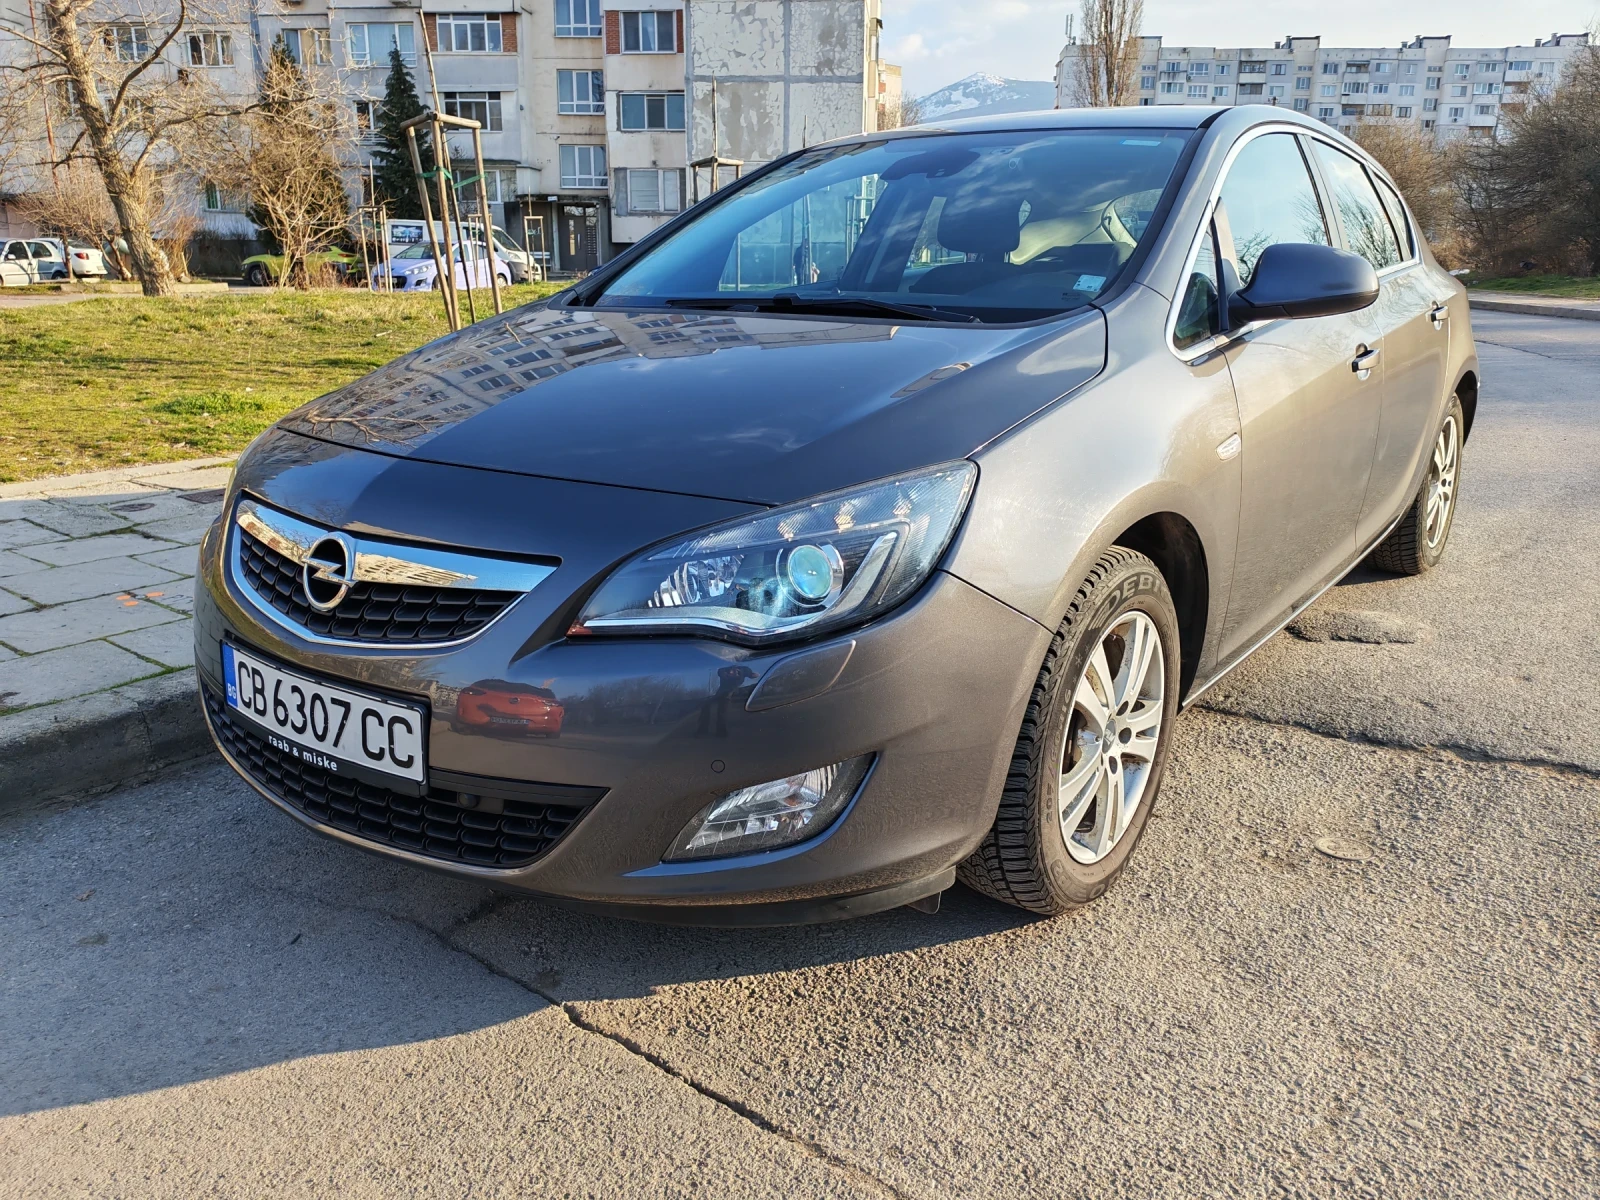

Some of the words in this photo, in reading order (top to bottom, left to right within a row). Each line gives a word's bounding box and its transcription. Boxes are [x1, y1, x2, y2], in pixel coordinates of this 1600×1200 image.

[227, 682, 237, 700] BG
[237, 660, 267, 717] CB
[273, 678, 351, 748] 6307
[361, 707, 414, 769] CC
[268, 734, 289, 753] raab
[292, 747, 299, 757] &
[303, 751, 338, 771] miske
